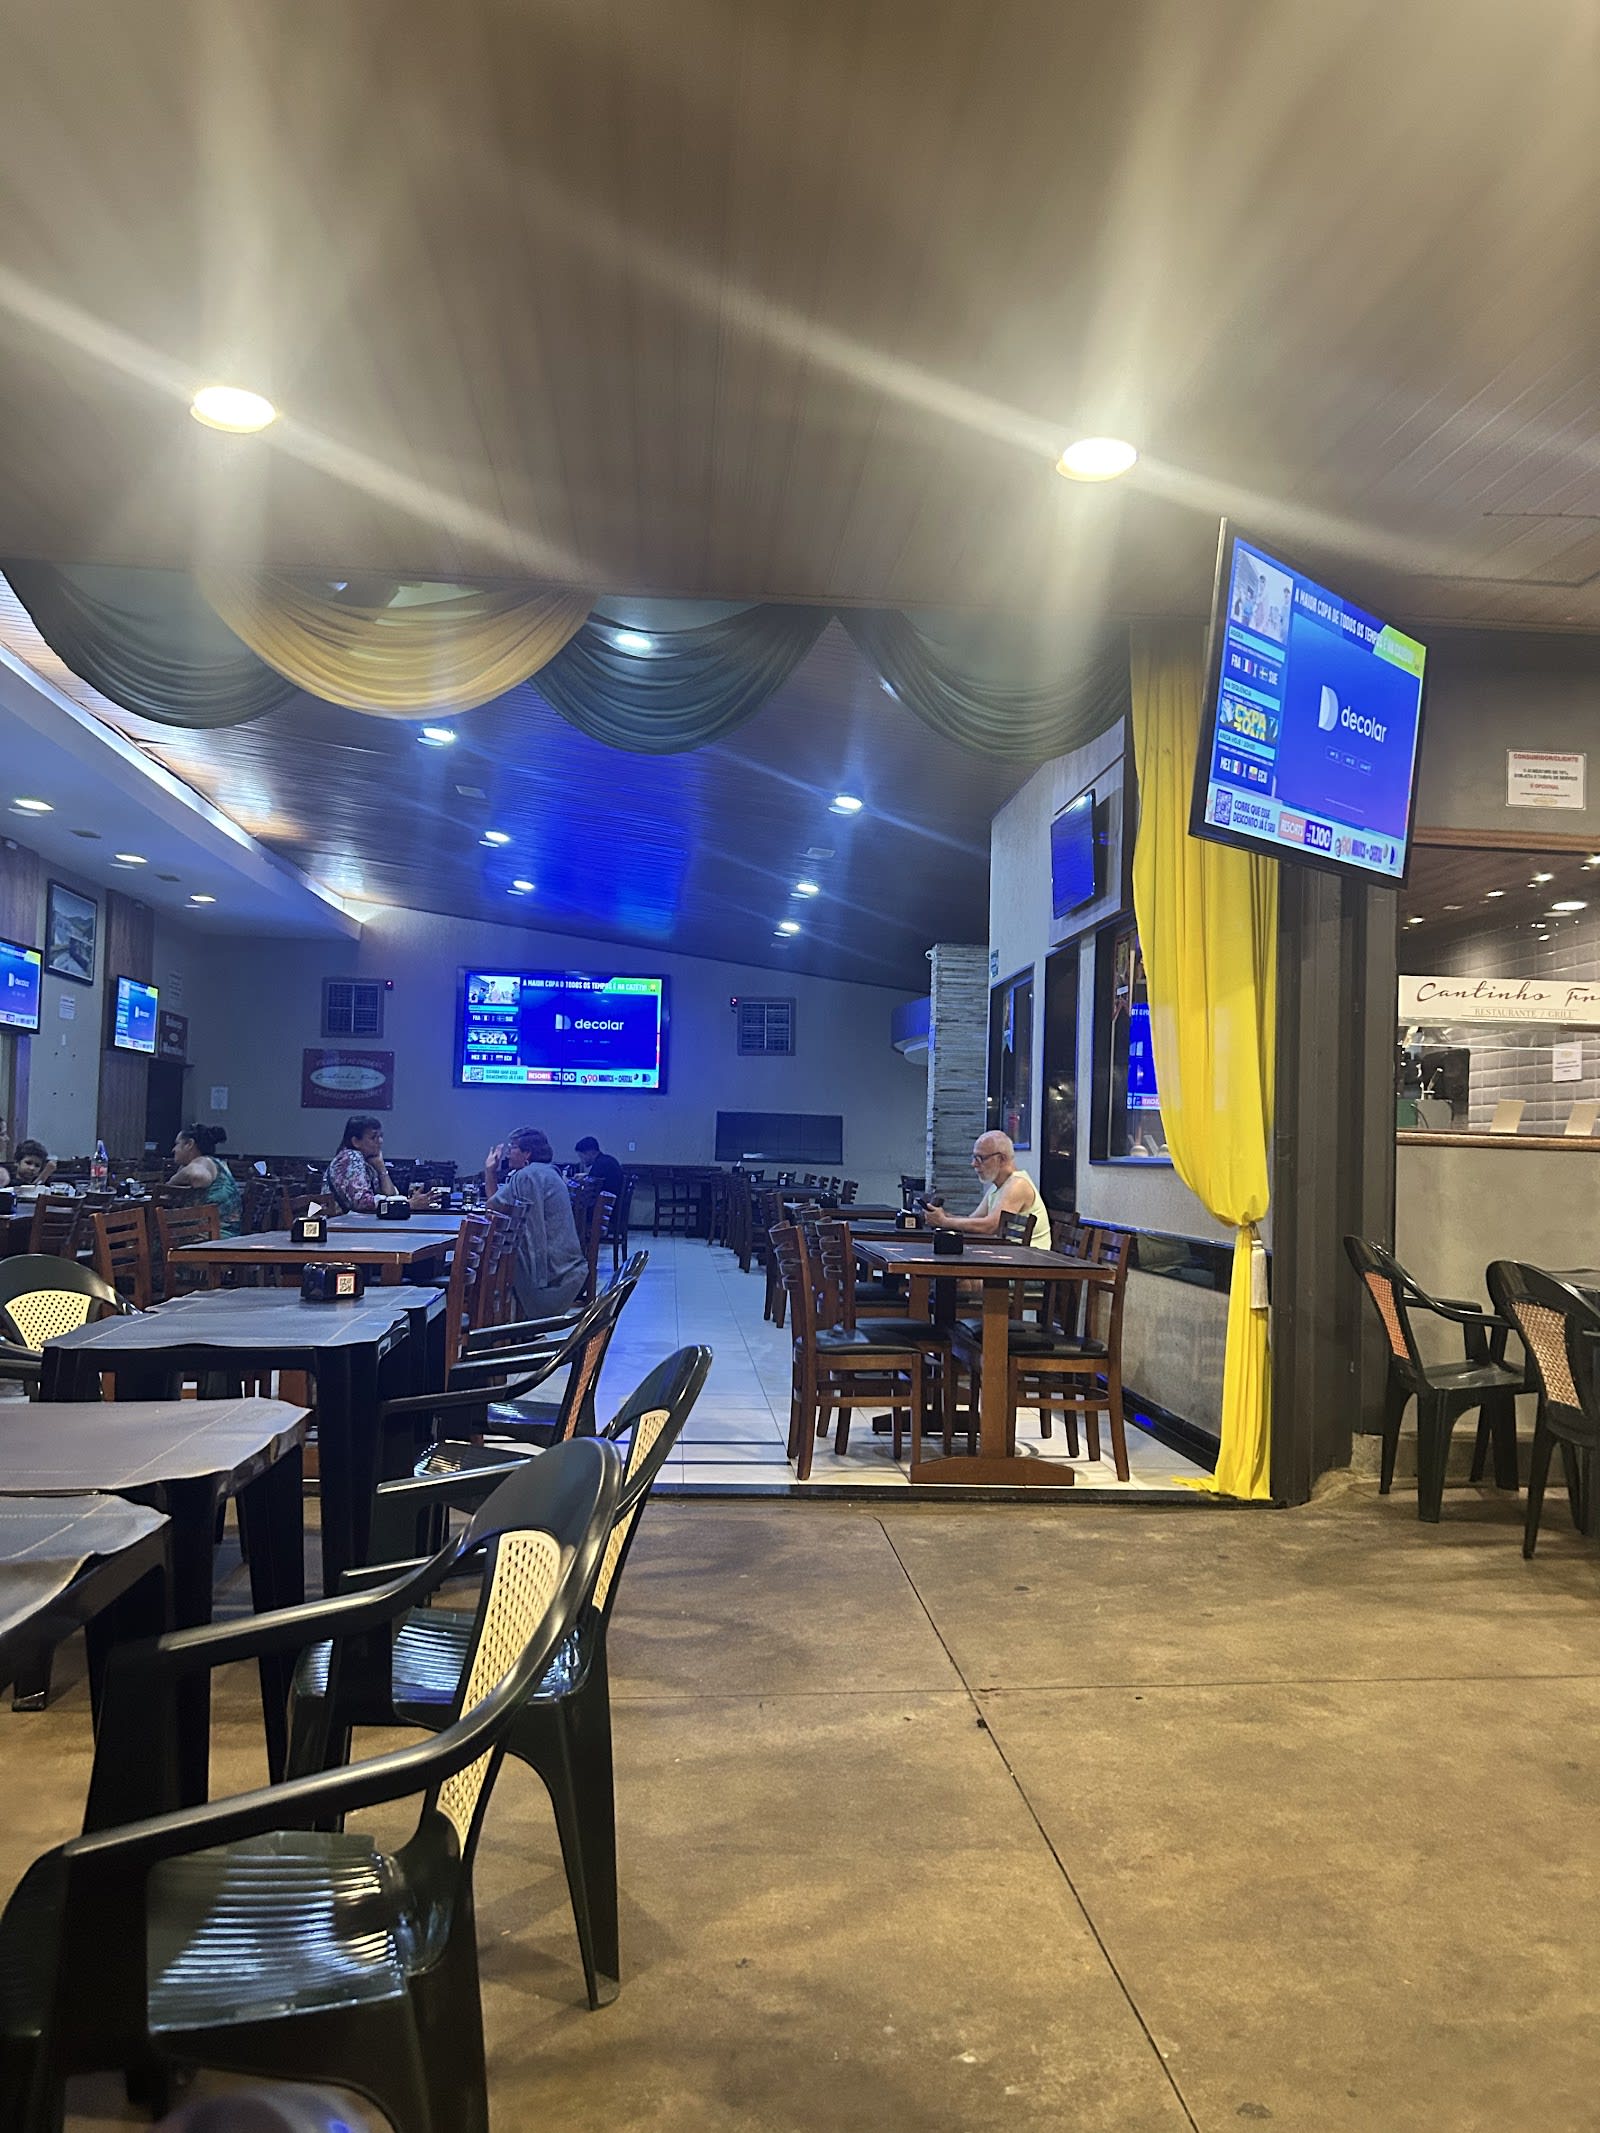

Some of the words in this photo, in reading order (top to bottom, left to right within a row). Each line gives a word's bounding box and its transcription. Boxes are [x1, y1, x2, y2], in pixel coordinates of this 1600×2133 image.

[1317, 599, 1332, 621] COPA
[1331, 607, 1340, 625] DE
[1340, 612, 1357, 636] TODOS
[1356, 622, 1365, 639] OS
[1341, 705, 1387, 743] decolar
[1251, 805, 1261, 816] QUE
[1416, 980, 1550, 1002] Cantinho
[574, 1018, 624, 1031] decolar
